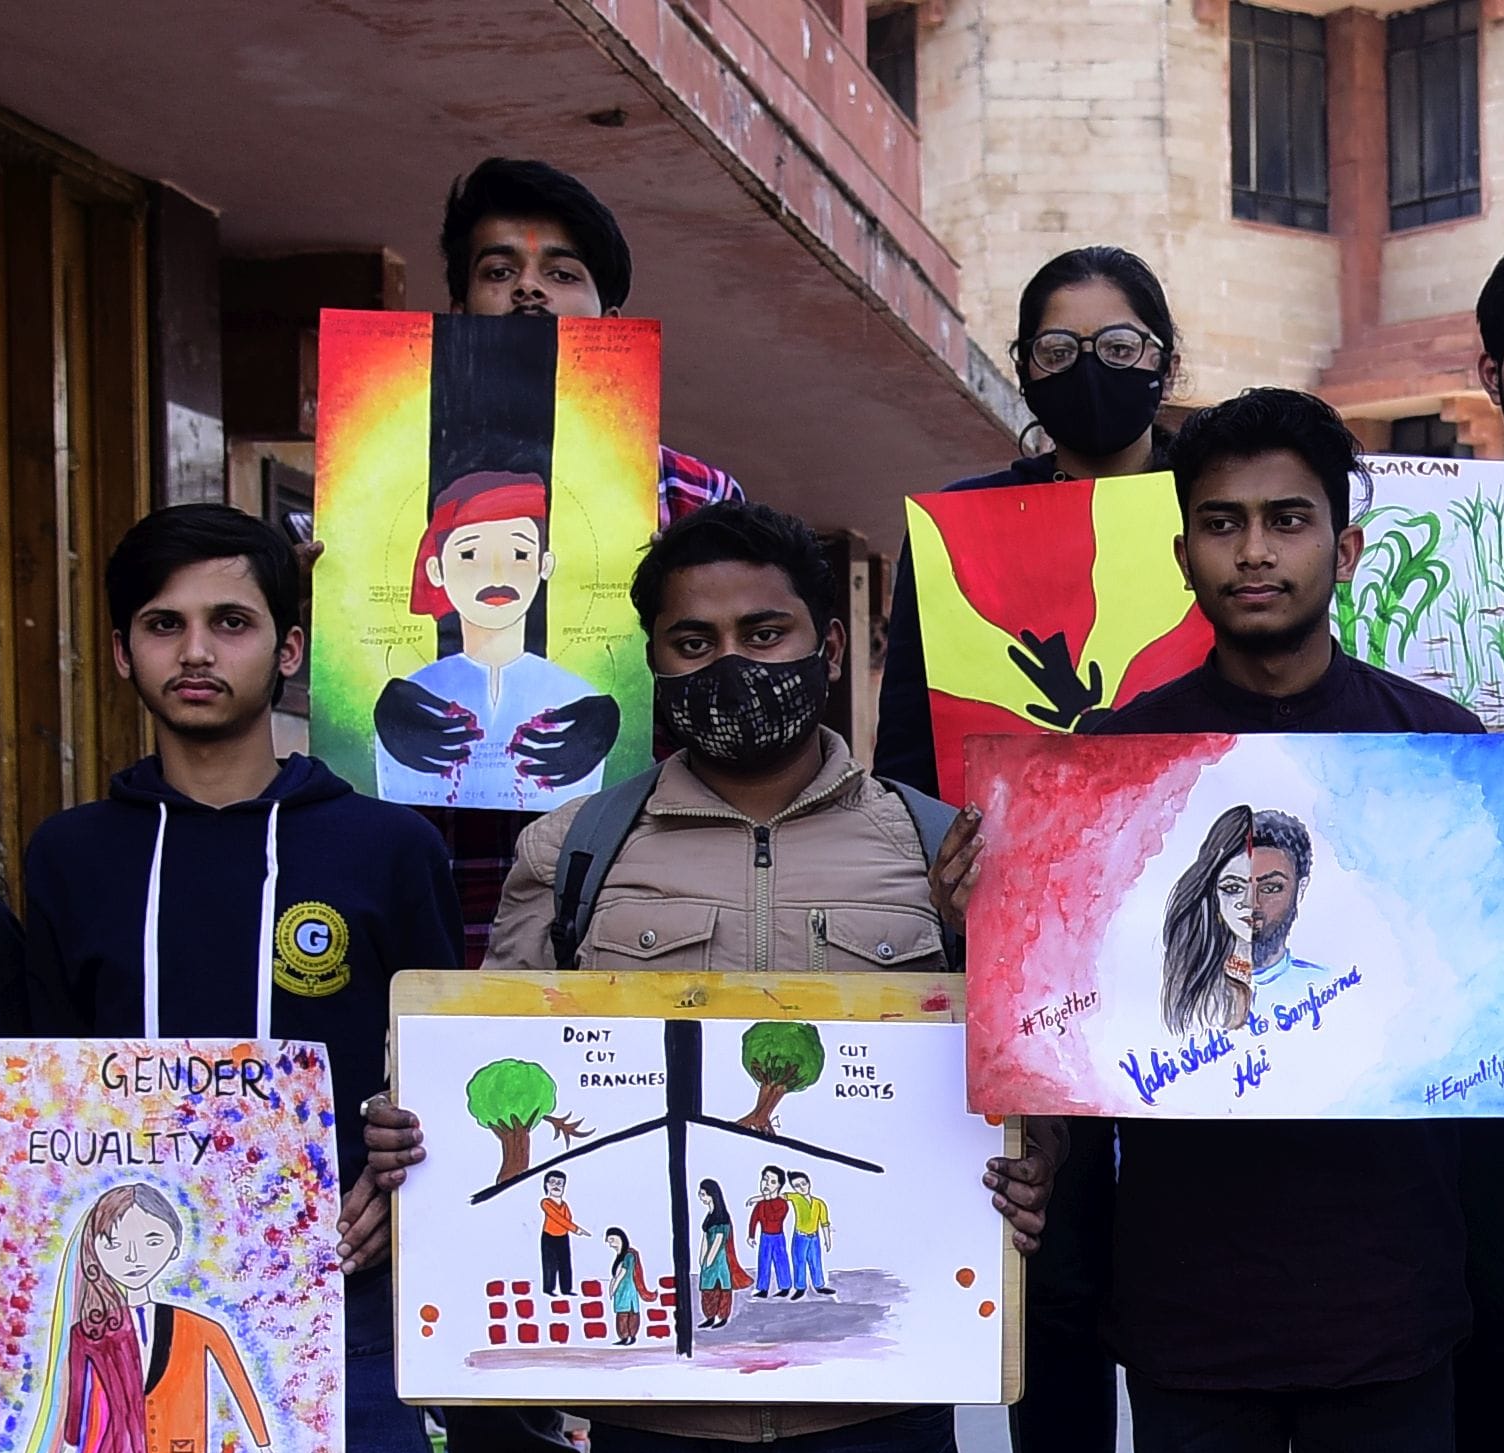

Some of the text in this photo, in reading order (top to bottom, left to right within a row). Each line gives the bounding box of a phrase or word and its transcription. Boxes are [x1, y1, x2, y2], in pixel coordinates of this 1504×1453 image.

[1366, 461, 1460, 477] GARCAN
[297, 922, 329, 954] G
[1018, 990, 1098, 1037] #Together
[562, 1025, 612, 1045] DONT
[585, 1049, 617, 1065] CUT
[839, 1044, 869, 1058] CUT
[101, 1052, 271, 1101] GENDER
[580, 1071, 666, 1089] BRANCHES
[841, 1064, 876, 1081] THE
[835, 1082, 894, 1100] ROOTS
[29, 1128, 213, 1167] EQUALITY
